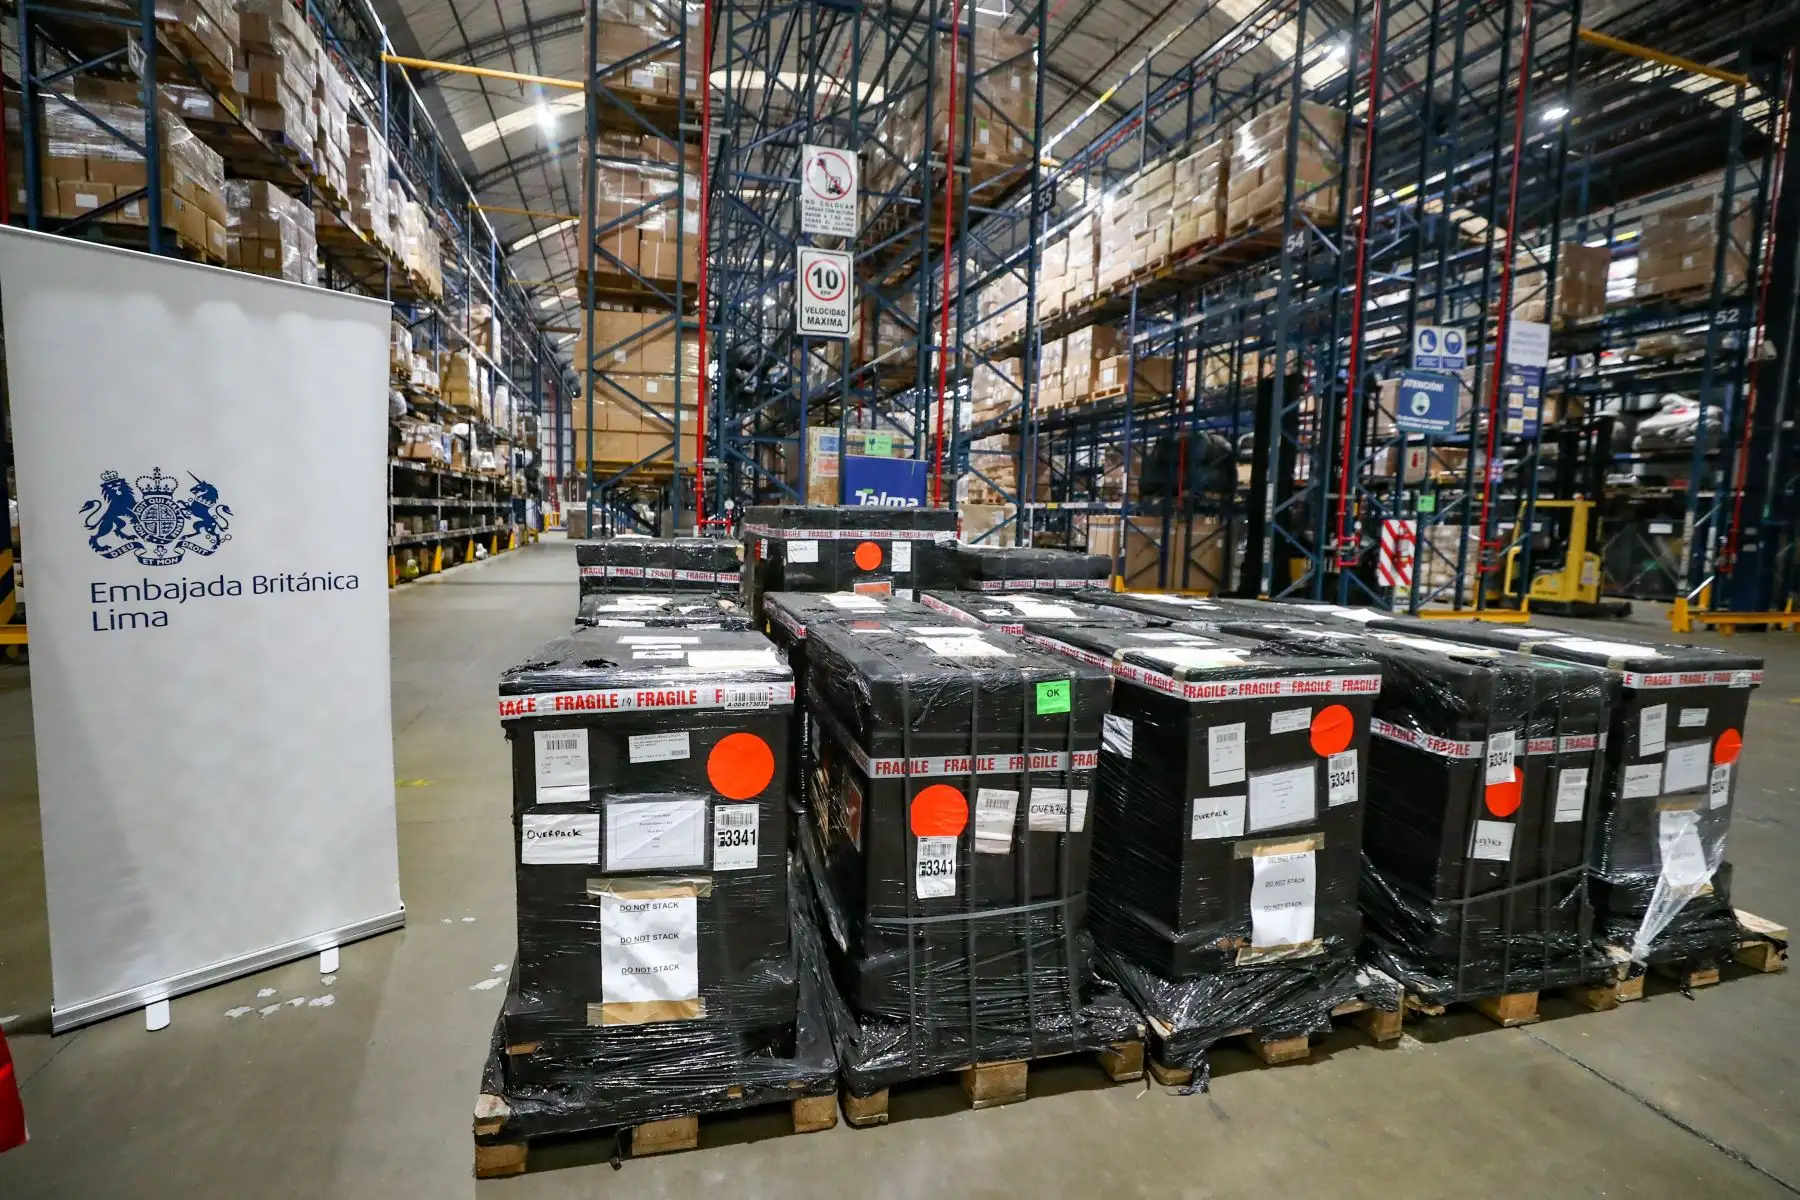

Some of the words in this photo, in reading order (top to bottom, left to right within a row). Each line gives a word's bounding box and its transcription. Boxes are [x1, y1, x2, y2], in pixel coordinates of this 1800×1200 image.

[1038, 186, 1052, 212] 55
[1286, 231, 1304, 253] 54
[812, 267, 838, 290] 10
[805, 306, 846, 316] VELOCIDAD
[1714, 308, 1739, 325] 52
[807, 316, 843, 327] MAXIMA
[855, 489, 919, 507] Talma
[111, 542, 135, 558] DIEU
[182, 542, 209, 556] DROIT
[156, 556, 179, 566] MON
[90, 575, 242, 604] Embajada
[252, 571, 359, 595] Británica
[92, 609, 168, 632] Lima
[1112, 664, 1137, 680] FRAGILE
[1144, 672, 1175, 693] FRAGILE
[1047, 689, 1060, 697] OK
[1183, 684, 1227, 698] FRAGILE
[1239, 682, 1280, 696] FRAGILE
[1292, 679, 1332, 693] FRAGILE
[1342, 679, 1379, 691] FRAGILE
[554, 693, 618, 711] FRAGILE
[636, 689, 697, 707] FRAGILE
[1380, 723, 1417, 743] FRAGILE
[1427, 735, 1471, 755] FRAGILE
[634, 934, 650, 942] NOT
[652, 933, 679, 941] STACK
[653, 964, 680, 973] STACK
